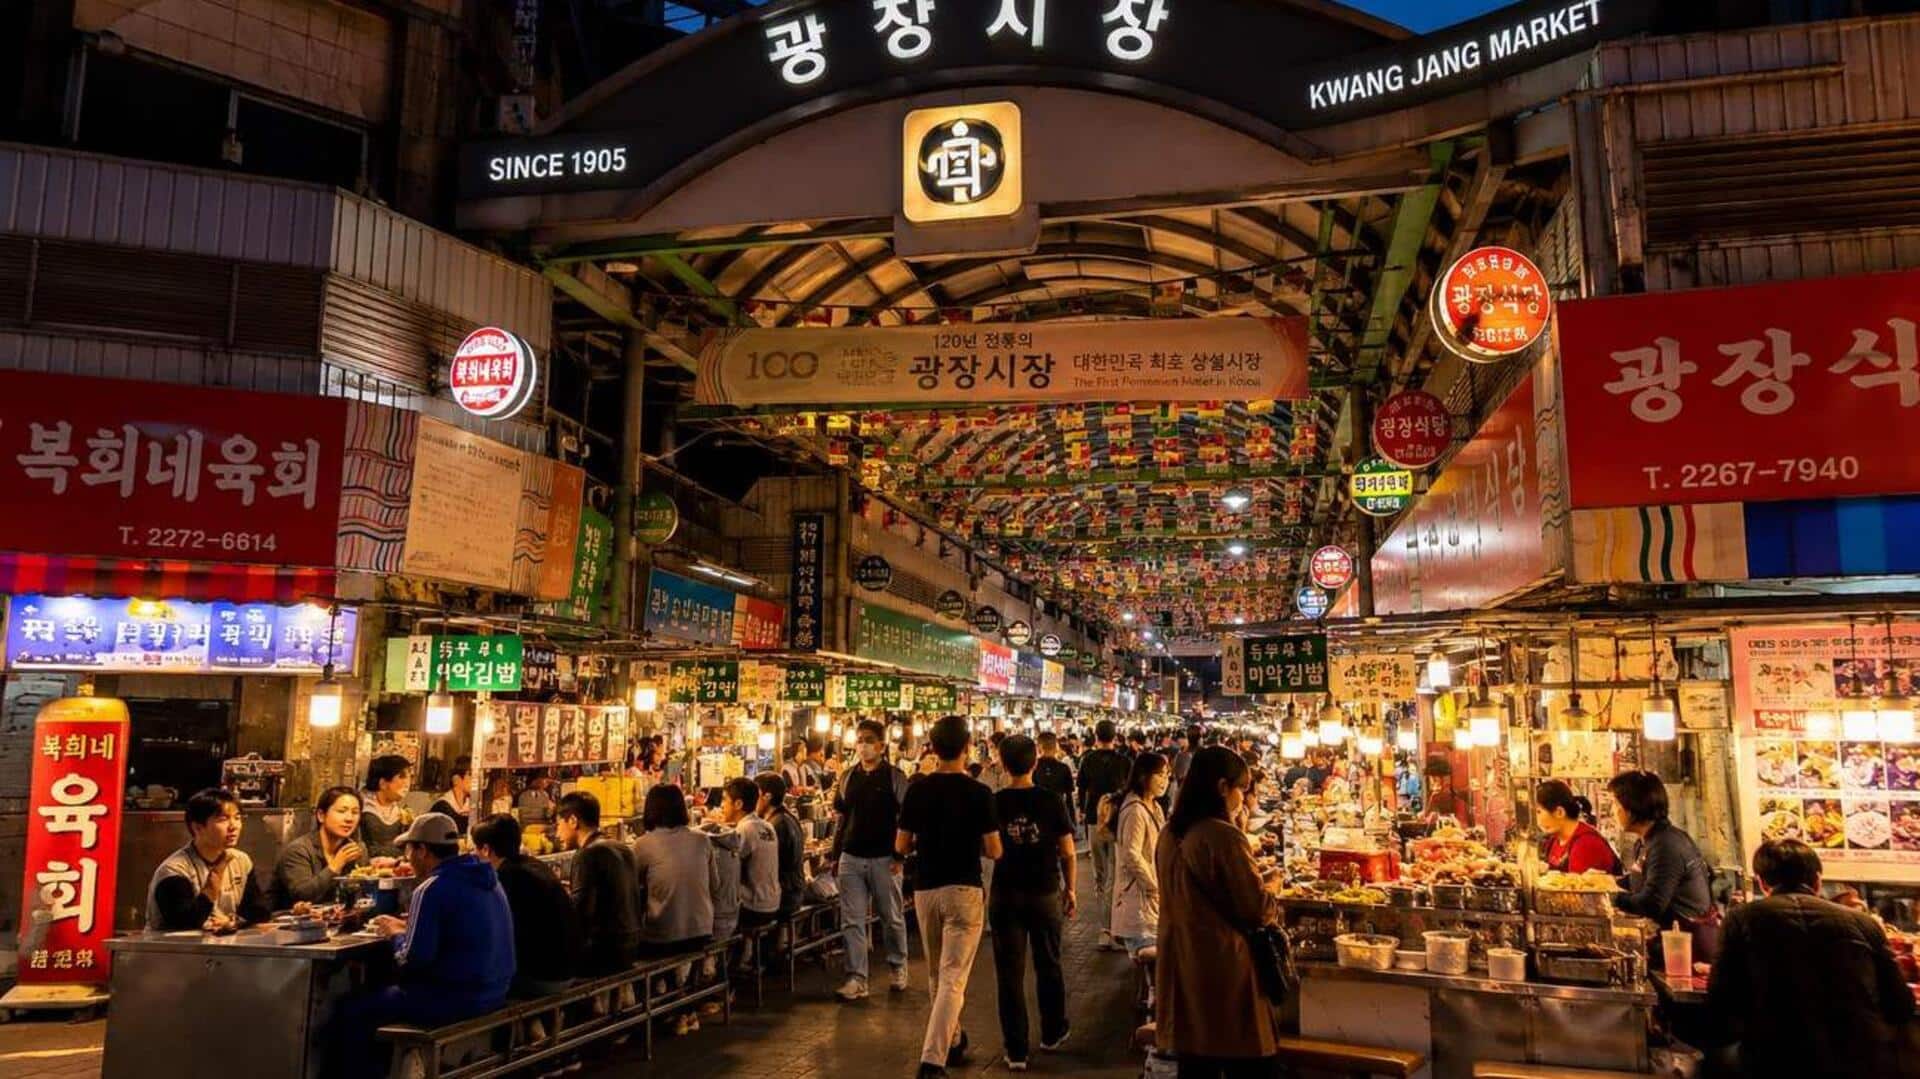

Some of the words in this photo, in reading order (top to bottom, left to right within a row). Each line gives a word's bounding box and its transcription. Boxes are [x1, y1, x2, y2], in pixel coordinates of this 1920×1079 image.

[1309, 65, 1404, 109] KWANG
[1411, 41, 1480, 86] JANG
[1489, 0, 1600, 61] MARKET
[489, 153, 564, 180] SINCE
[571, 147, 627, 175] 1905
[933, 333, 977, 349] 120년
[909, 353, 1057, 390] 광장시장
[1603, 317, 1920, 424] 광장식
[1642, 466, 1670, 490] T.
[1680, 455, 1860, 488] 2267-7940
[148, 527, 278, 552] 2272-6614
[37, 772, 108, 934] 육회
